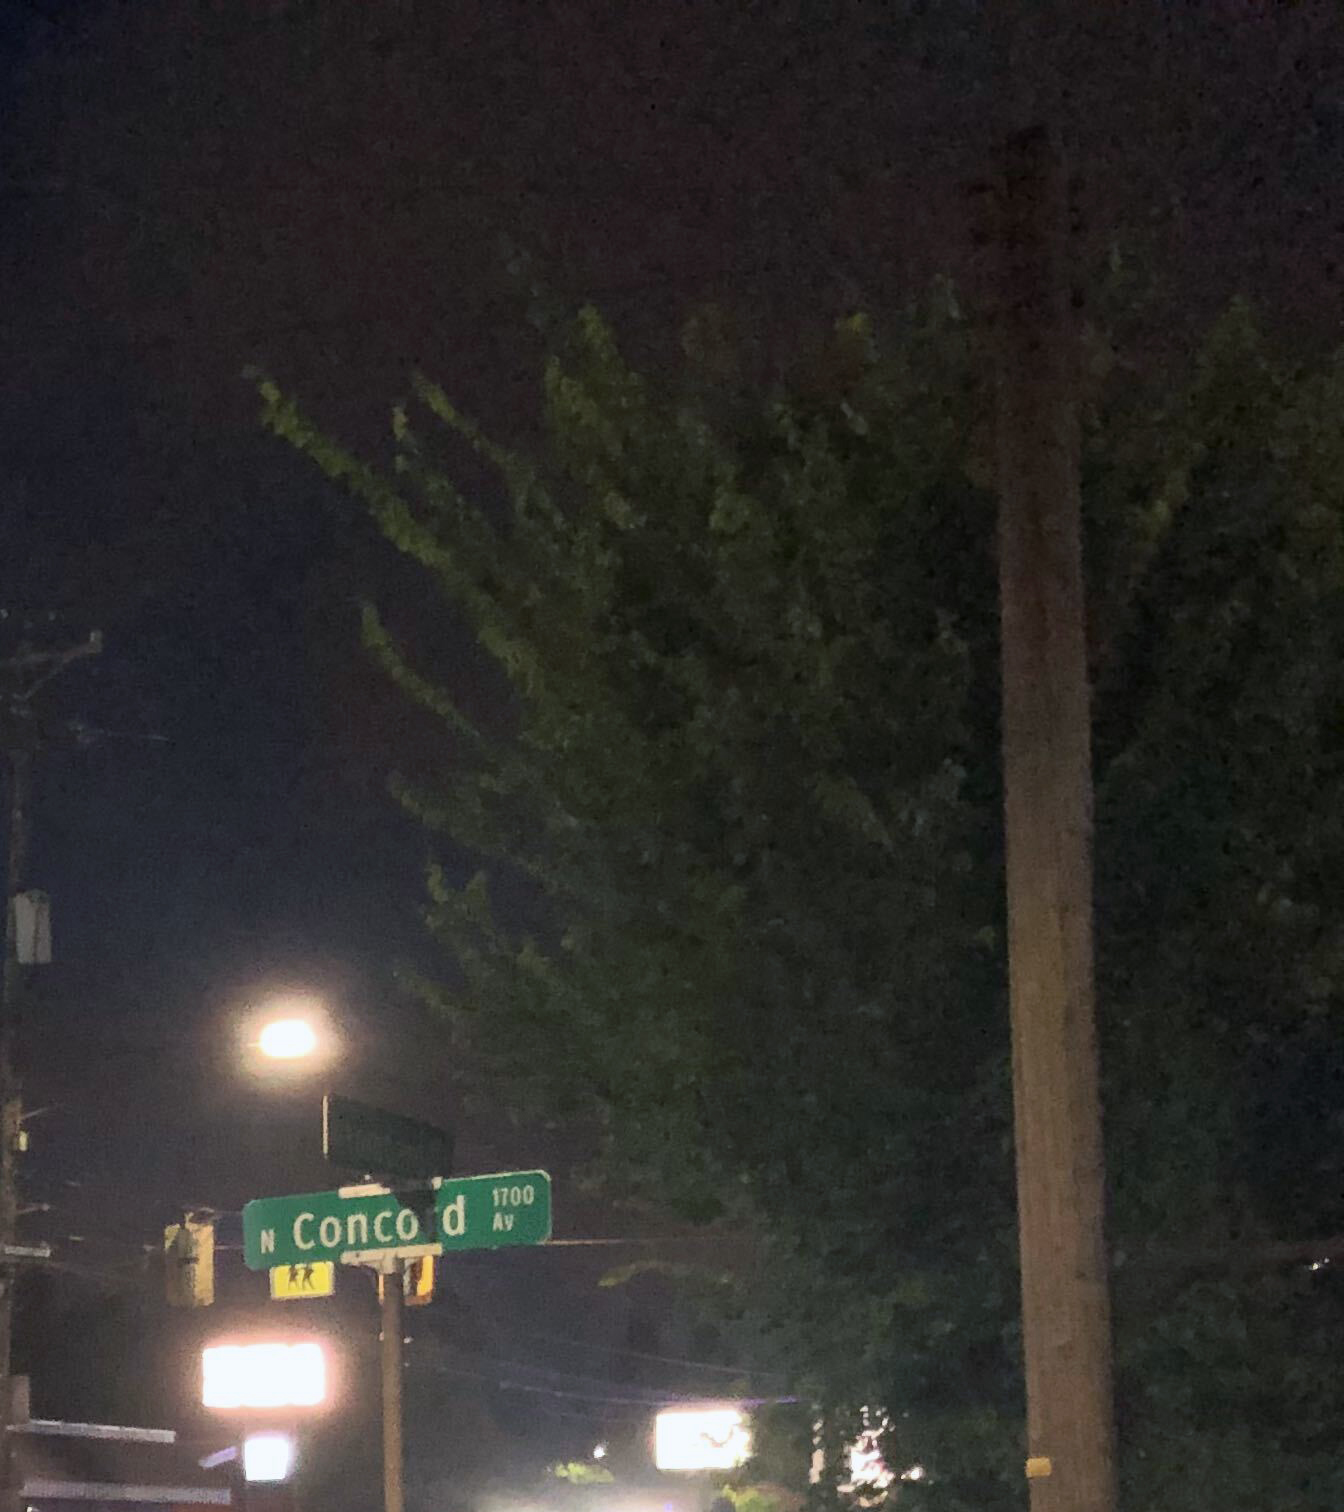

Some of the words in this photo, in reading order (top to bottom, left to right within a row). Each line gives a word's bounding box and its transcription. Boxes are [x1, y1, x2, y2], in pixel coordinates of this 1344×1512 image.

[492, 1185, 535, 1207] 1700
[260, 1228, 276, 1254] N
[293, 1195, 466, 1250] Concod
[492, 1212, 514, 1233] Av
